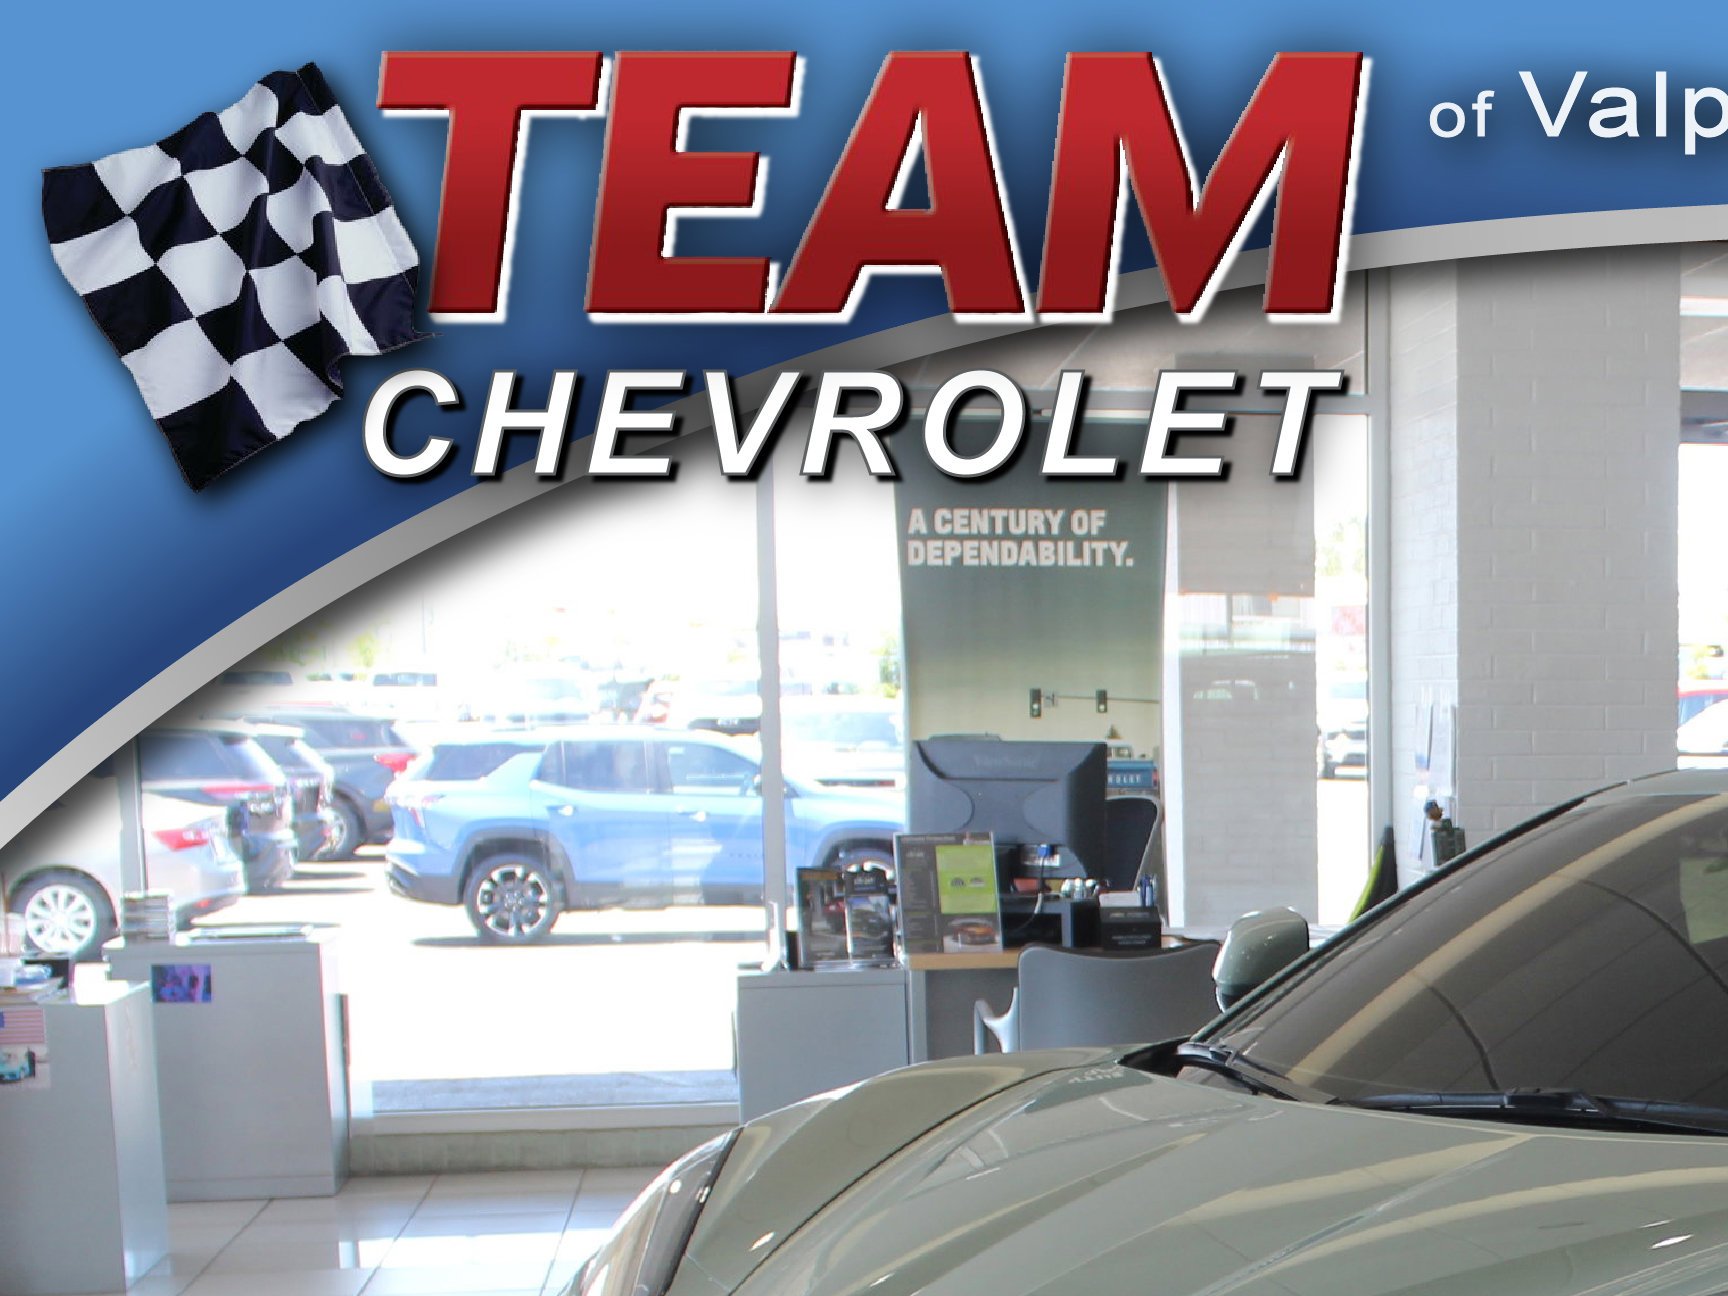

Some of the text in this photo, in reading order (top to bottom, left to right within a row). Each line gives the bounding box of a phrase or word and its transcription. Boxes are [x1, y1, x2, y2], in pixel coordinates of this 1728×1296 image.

[907, 508, 1107, 535] A CENTURY OF
[907, 540, 1134, 567] DEPENDABILITY.
